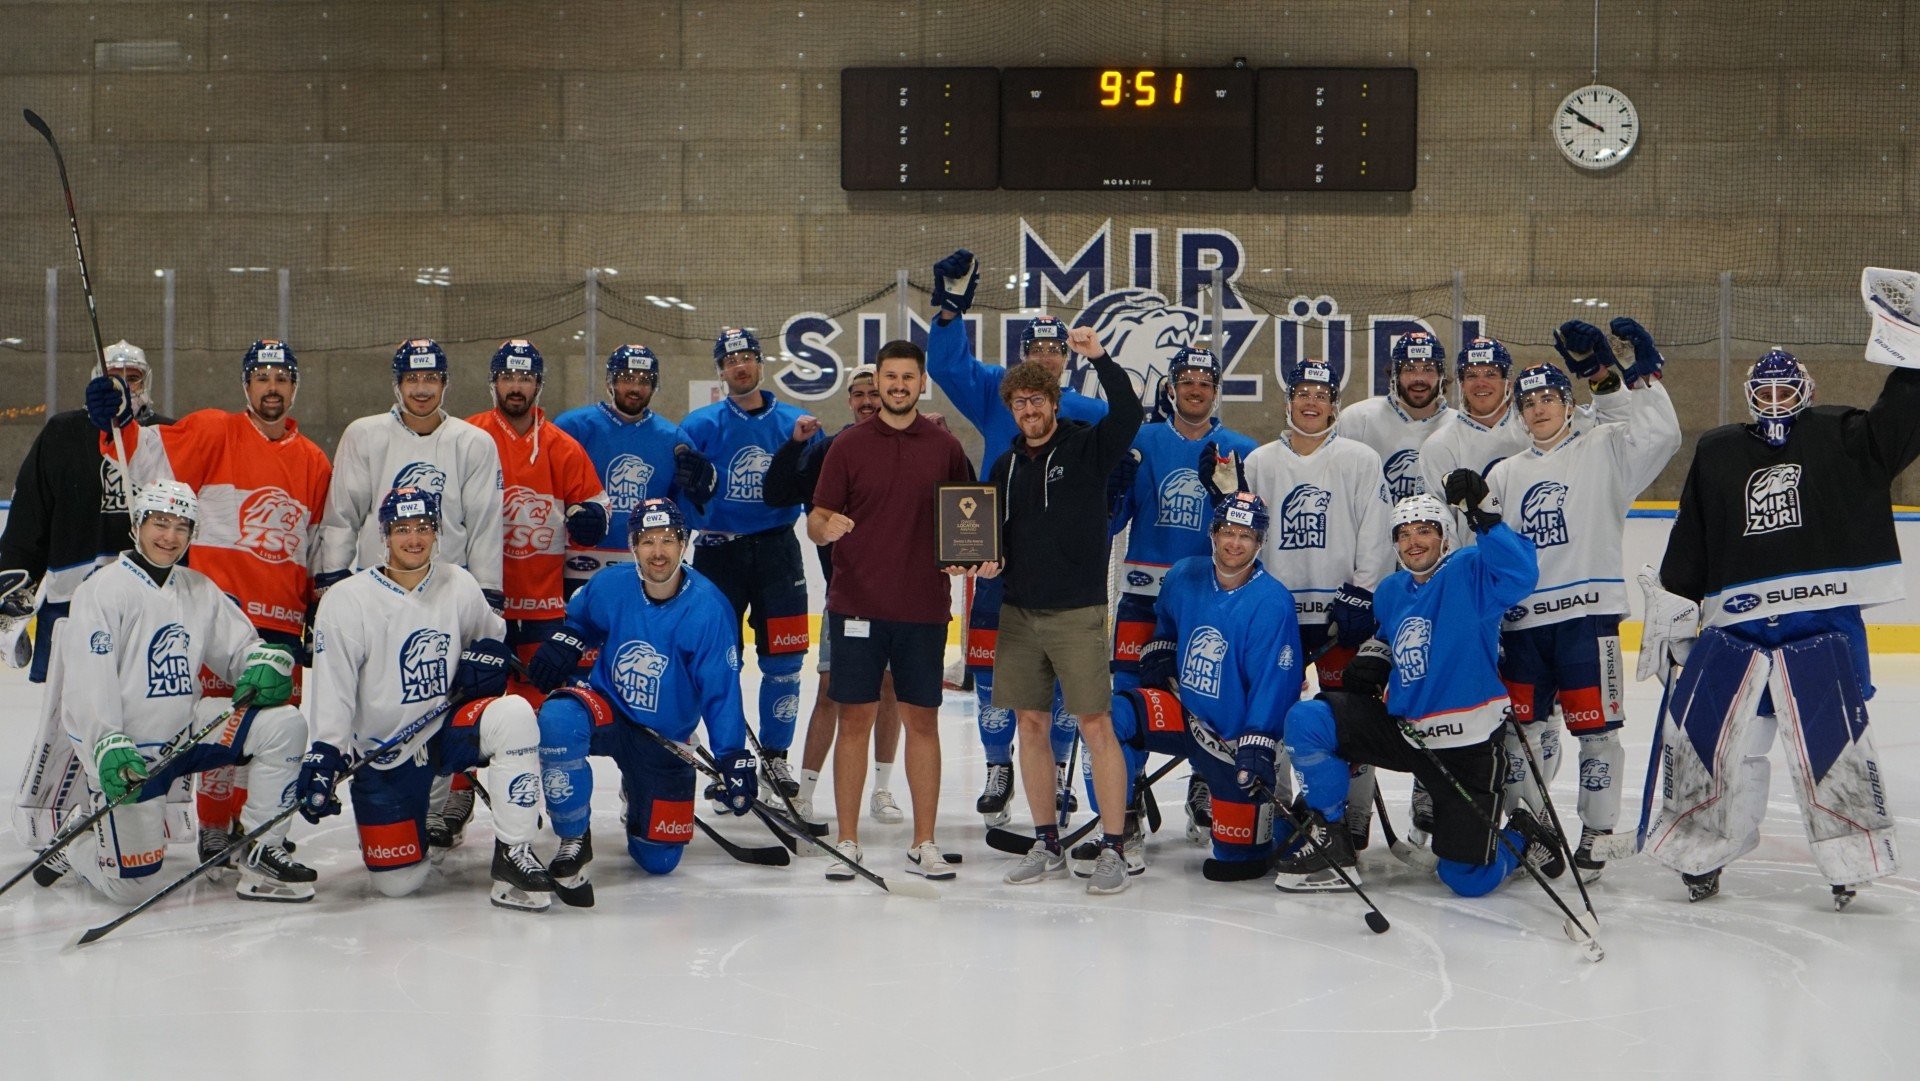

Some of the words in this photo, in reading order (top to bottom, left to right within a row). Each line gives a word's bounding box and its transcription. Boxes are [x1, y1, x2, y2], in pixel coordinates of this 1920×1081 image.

[1100, 71, 1183, 106] 9:51
[1020, 217, 1250, 313] MIR
[1037, 326, 1052, 334] ewz
[728, 340, 743, 348] ewz
[1410, 346, 1426, 354] ewz
[1874, 338, 1906, 361] BAUER
[261, 351, 278, 359] ewz
[413, 356, 429, 364] ewz
[510, 358, 526, 366] ewz
[1471, 351, 1487, 359] ewz
[1308, 369, 1324, 377] ewz
[1523, 376, 1539, 386] ewz
[1767, 423, 1784, 440] 40
[731, 473, 763, 487] MIR
[609, 484, 638, 498] MIR
[732, 485, 763, 499] ZÜR
[400, 503, 418, 512] ewz
[609, 493, 640, 509] ZÜR
[1161, 495, 1194, 512] MIR
[1750, 493, 1788, 514] MIR
[646, 513, 662, 522] ewz
[1160, 508, 1198, 527] ZÜRI
[1230, 510, 1247, 519] ewz
[1523, 513, 1560, 532] MIR
[1750, 507, 1797, 530] ZÜRI
[1283, 514, 1318, 533] MIR
[1283, 529, 1324, 548] ZÜRI
[370, 569, 405, 596] STADLER
[1335, 590, 1372, 609] AUER
[1766, 582, 1847, 604] SUBARU
[1295, 601, 1333, 614] SUBA
[91, 643, 113, 652] ZSC
[551, 631, 585, 651] BAU
[461, 651, 504, 668] AUER
[969, 646, 995, 659] Adec
[1361, 645, 1392, 657] BAU
[1394, 648, 1421, 668] MIR
[151, 657, 189, 679] MIR
[403, 663, 438, 685] MIR
[1186, 656, 1213, 678] MIR
[151, 673, 192, 696] ZÜR
[405, 678, 446, 702] ZÜRI
[615, 672, 648, 692] MIR
[1147, 688, 1166, 728] decco
[1564, 709, 1600, 723] decco
[220, 702, 247, 747] MIGR
[1055, 717, 1078, 727] ZS
[1239, 735, 1275, 749] WARR
[1664, 743, 1674, 800] BAUER
[1580, 775, 1612, 788] ZSC
[1866, 759, 1886, 817] BAUER
[1213, 821, 1251, 838] decco
[121, 849, 164, 867] MIGR
[367, 843, 416, 859] Adecco
